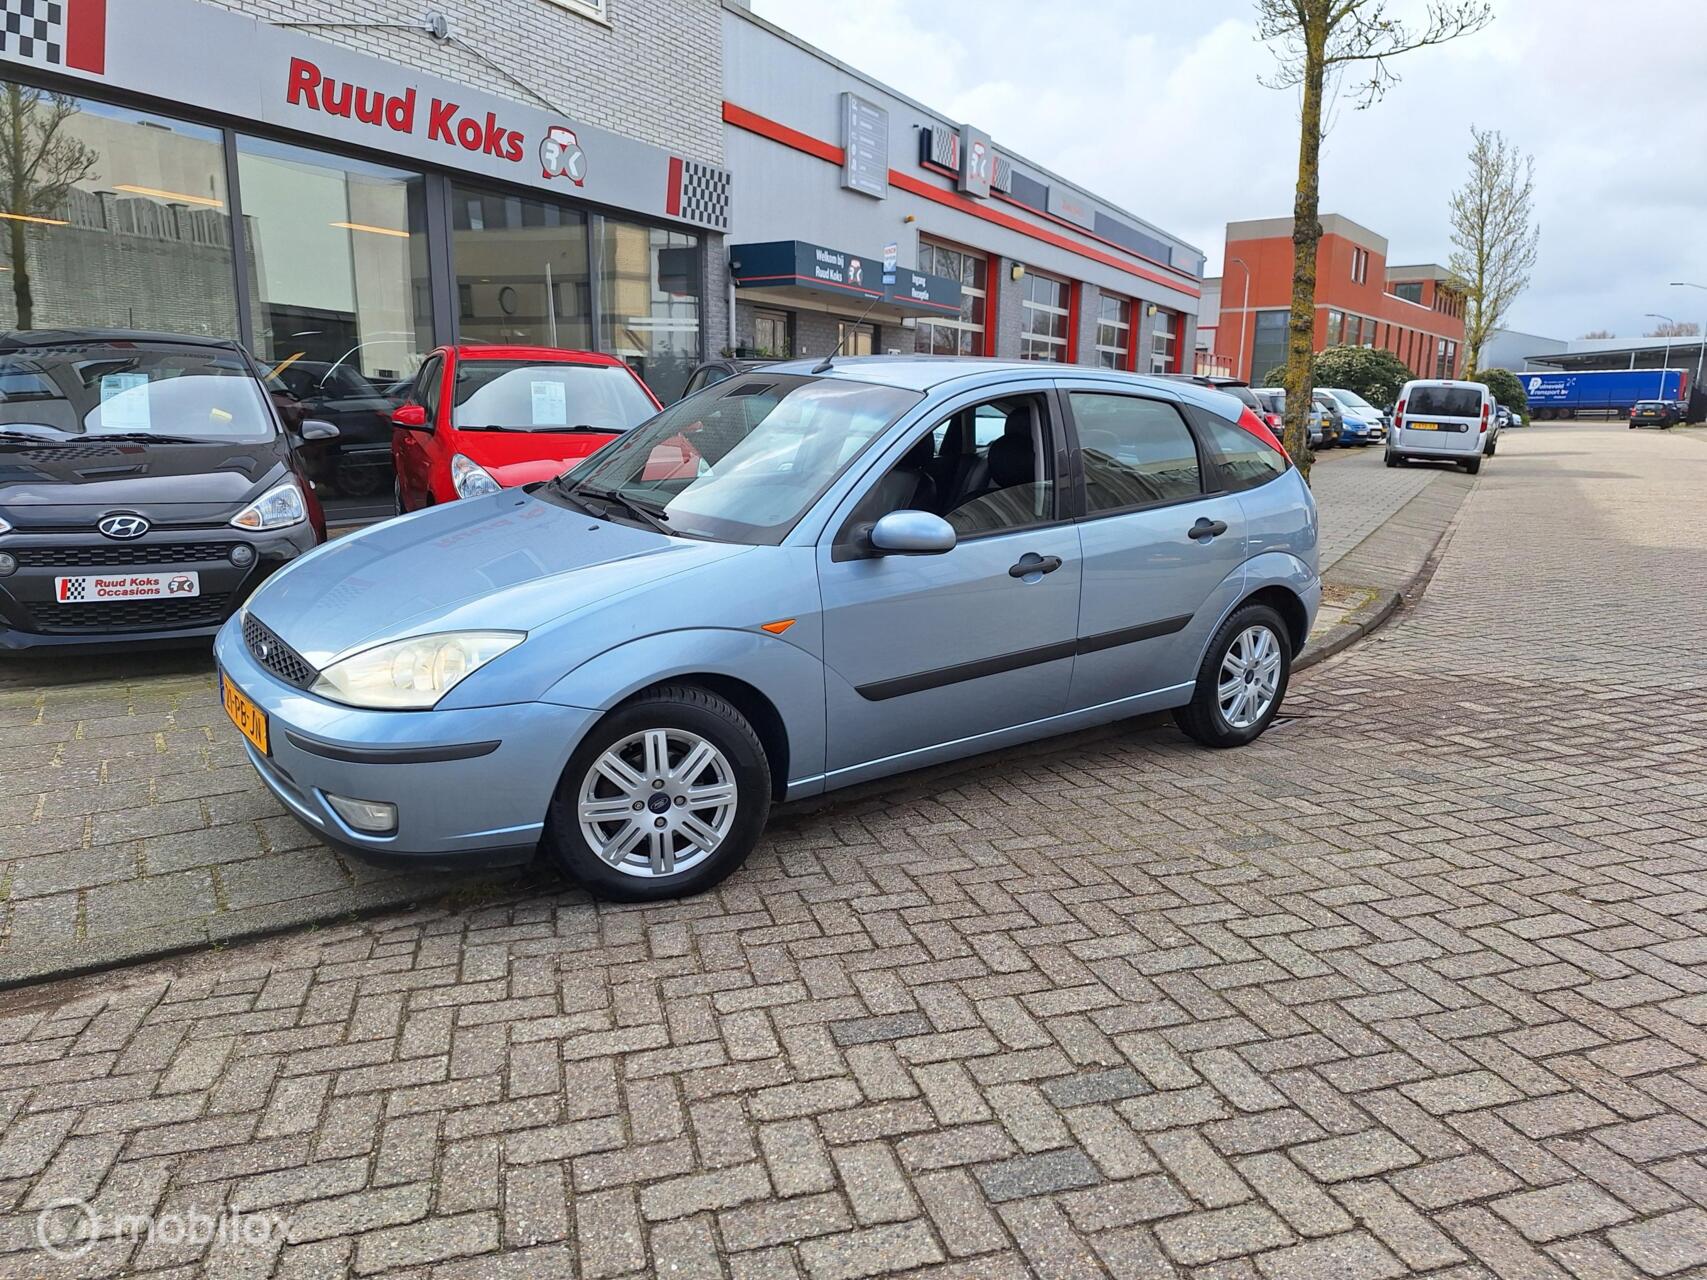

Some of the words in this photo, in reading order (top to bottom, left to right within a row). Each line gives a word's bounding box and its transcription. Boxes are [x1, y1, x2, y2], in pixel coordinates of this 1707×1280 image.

[286, 56, 417, 134] Ruud
[427, 97, 525, 162] Koks
[815, 248, 837, 265] Welkom
[815, 265, 830, 280] Ruud
[830, 269, 843, 282] Koks
[94, 578, 127, 588] Ruud
[129, 577, 160, 587] Koks
[97, 586, 161, 597] Occasions
